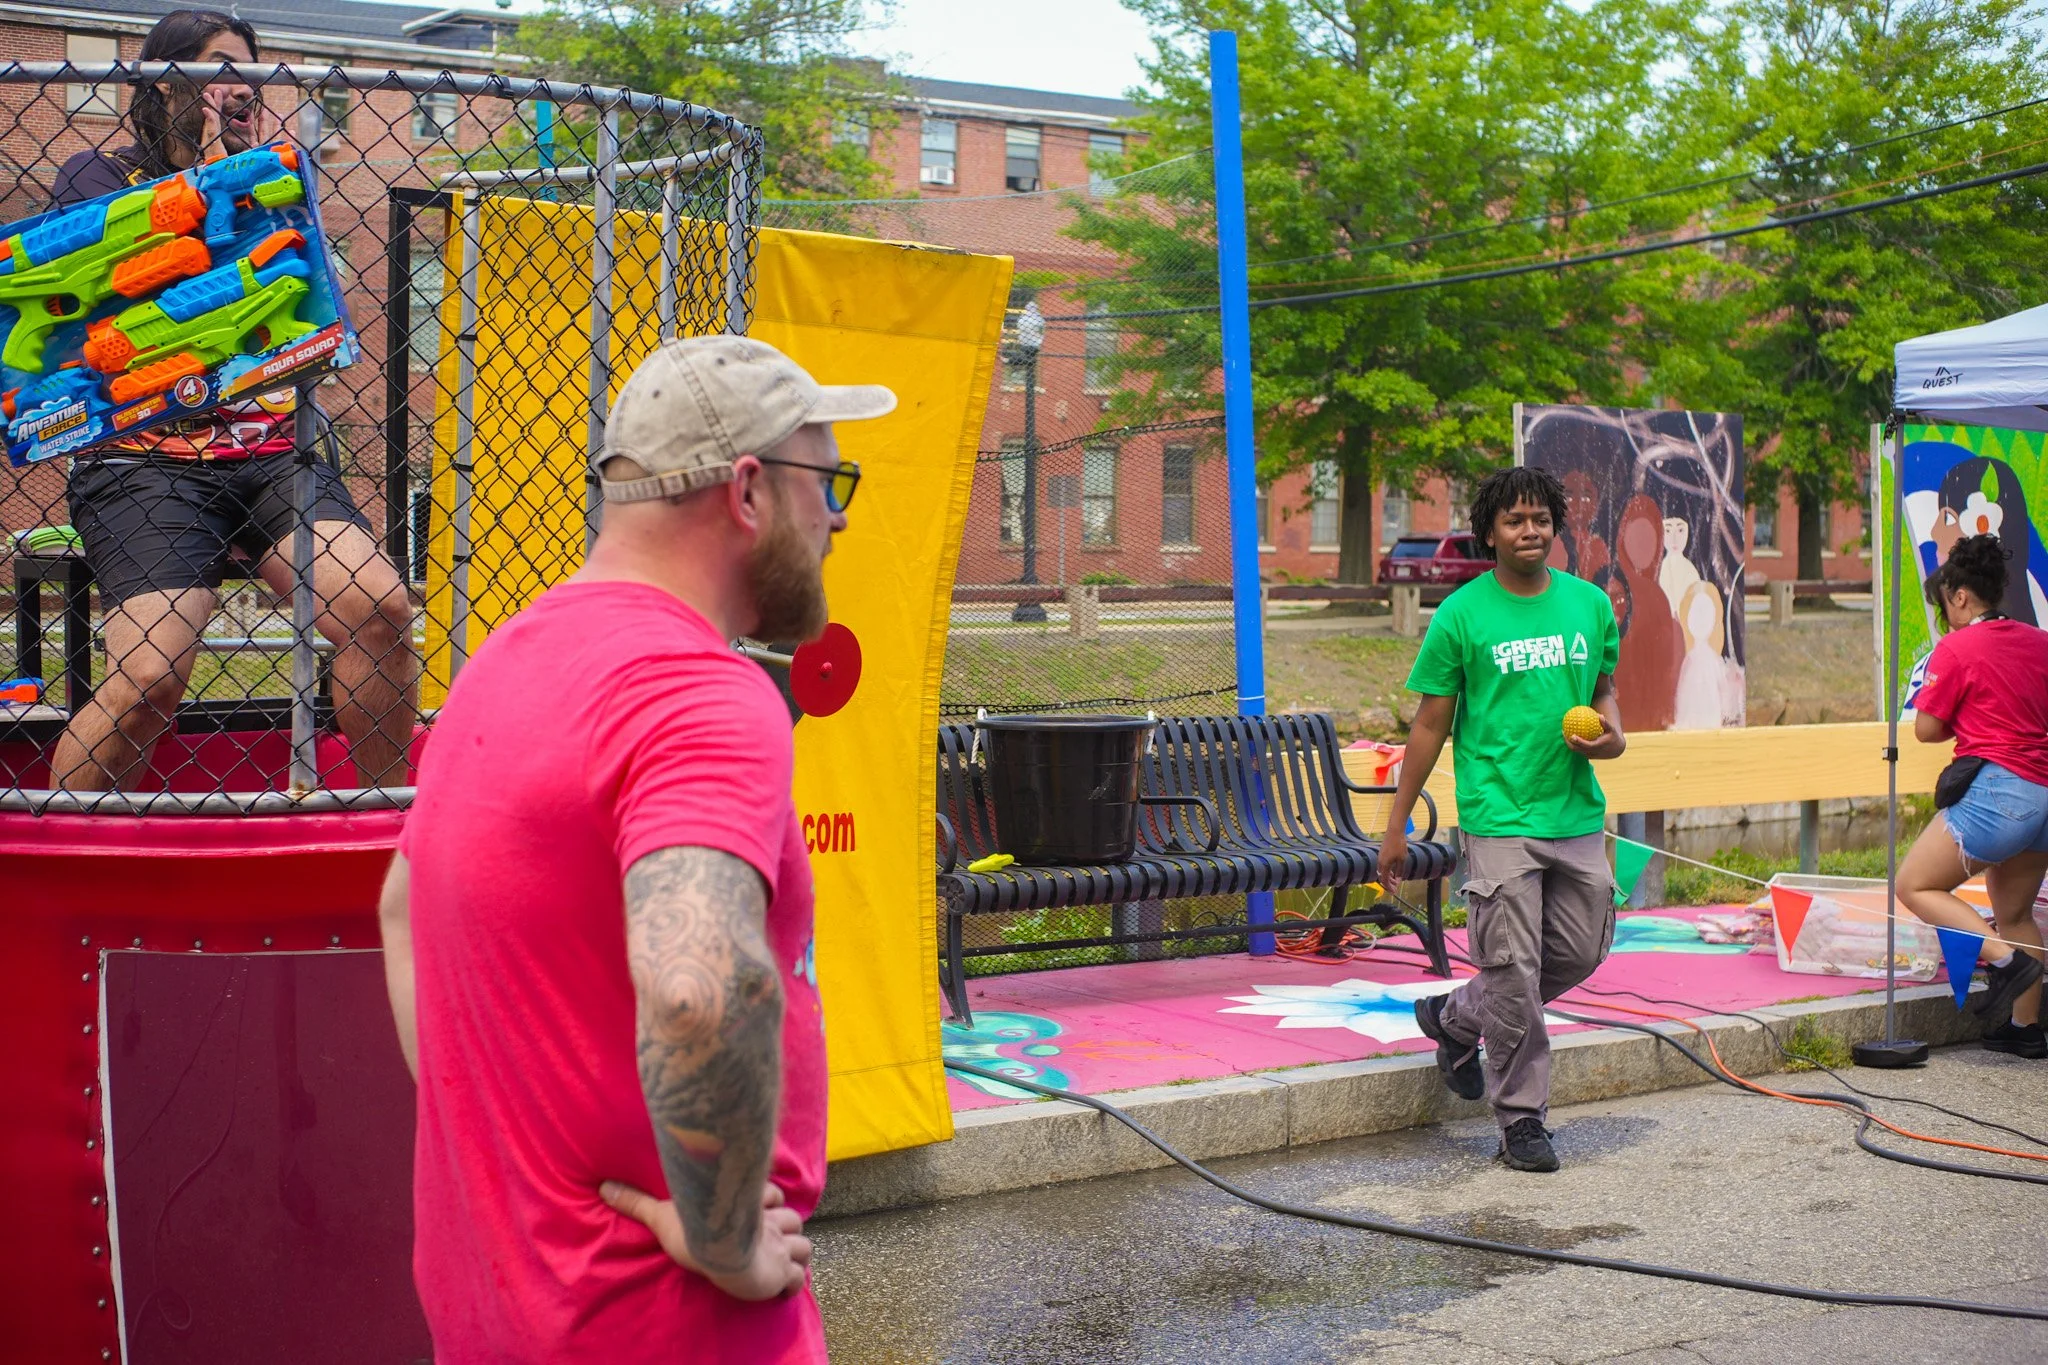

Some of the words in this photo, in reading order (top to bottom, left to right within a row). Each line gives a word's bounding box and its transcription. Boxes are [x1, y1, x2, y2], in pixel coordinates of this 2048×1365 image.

[263, 355, 295, 376] AQUA
[295, 337, 336, 361] SQUAD
[183, 378, 197, 396] 4
[1922, 373, 1964, 389] QUEST
[17, 400, 87, 443] ADVENTURE
[137, 407, 151, 420] 30
[40, 437, 64, 453] WATER
[65, 425, 90, 442] STRIKE
[43, 415, 82, 438] FORCE
[1497, 634, 1564, 658] GREEN
[1495, 648, 1566, 675] TEAM
[802, 812, 856, 854] com
